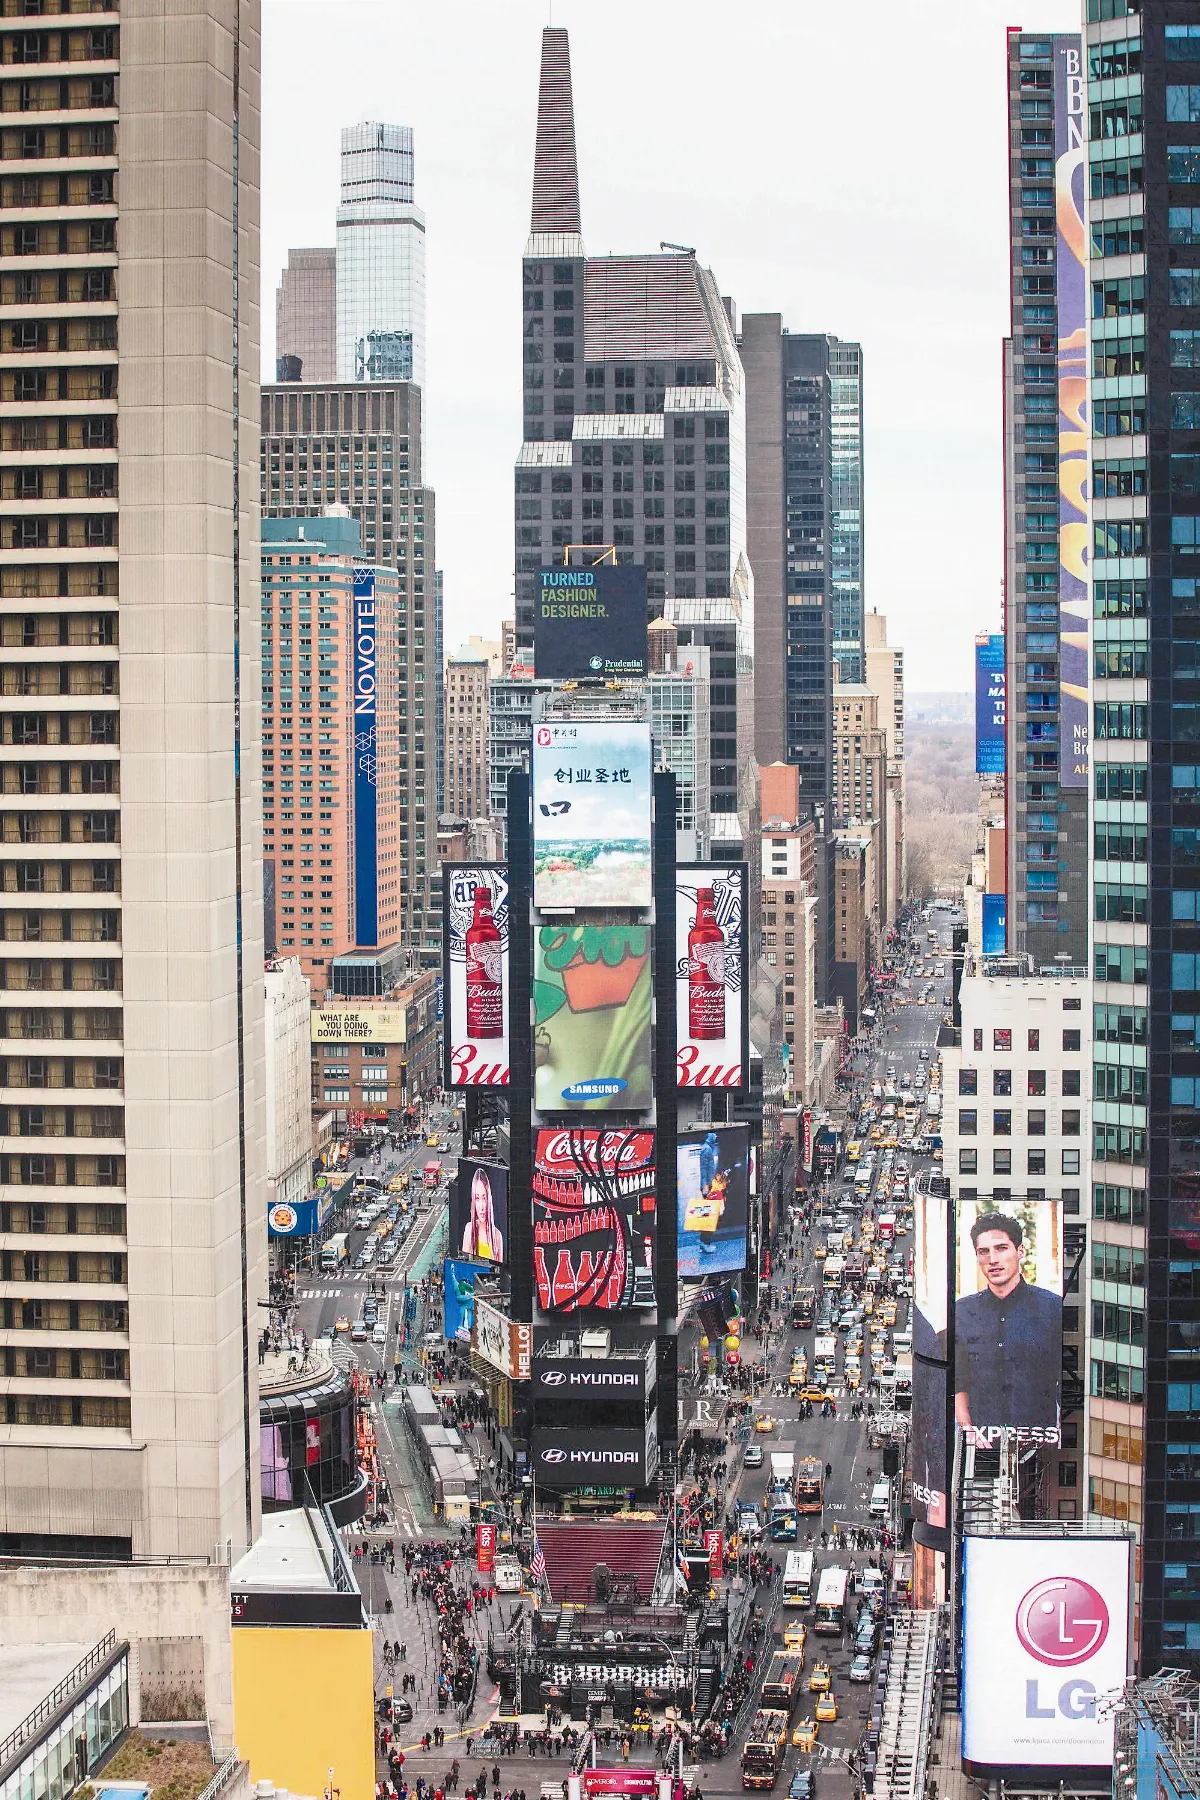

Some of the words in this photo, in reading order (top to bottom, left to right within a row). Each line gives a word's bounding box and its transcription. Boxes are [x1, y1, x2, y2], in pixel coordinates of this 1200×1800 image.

[541, 573, 594, 586] TURNED
[541, 589, 597, 602] FASHION
[541, 604, 609, 618] DESIGNER.
[354, 584, 376, 714] NOVOTEL
[605, 660, 643, 668] Prudential
[554, 767, 632, 783] 创业圣地
[317, 1030, 342, 1038] DOWN
[569, 1085, 619, 1094] SAMSUNG
[518, 1325, 530, 1376] HELLO!
[570, 1373, 639, 1385] HYUNDAI
[570, 1451, 639, 1463] HYUNDAI
[481, 1527, 493, 1547] tkts
[709, 1532, 720, 1553] tkts
[1025, 1678, 1097, 1720] LG
